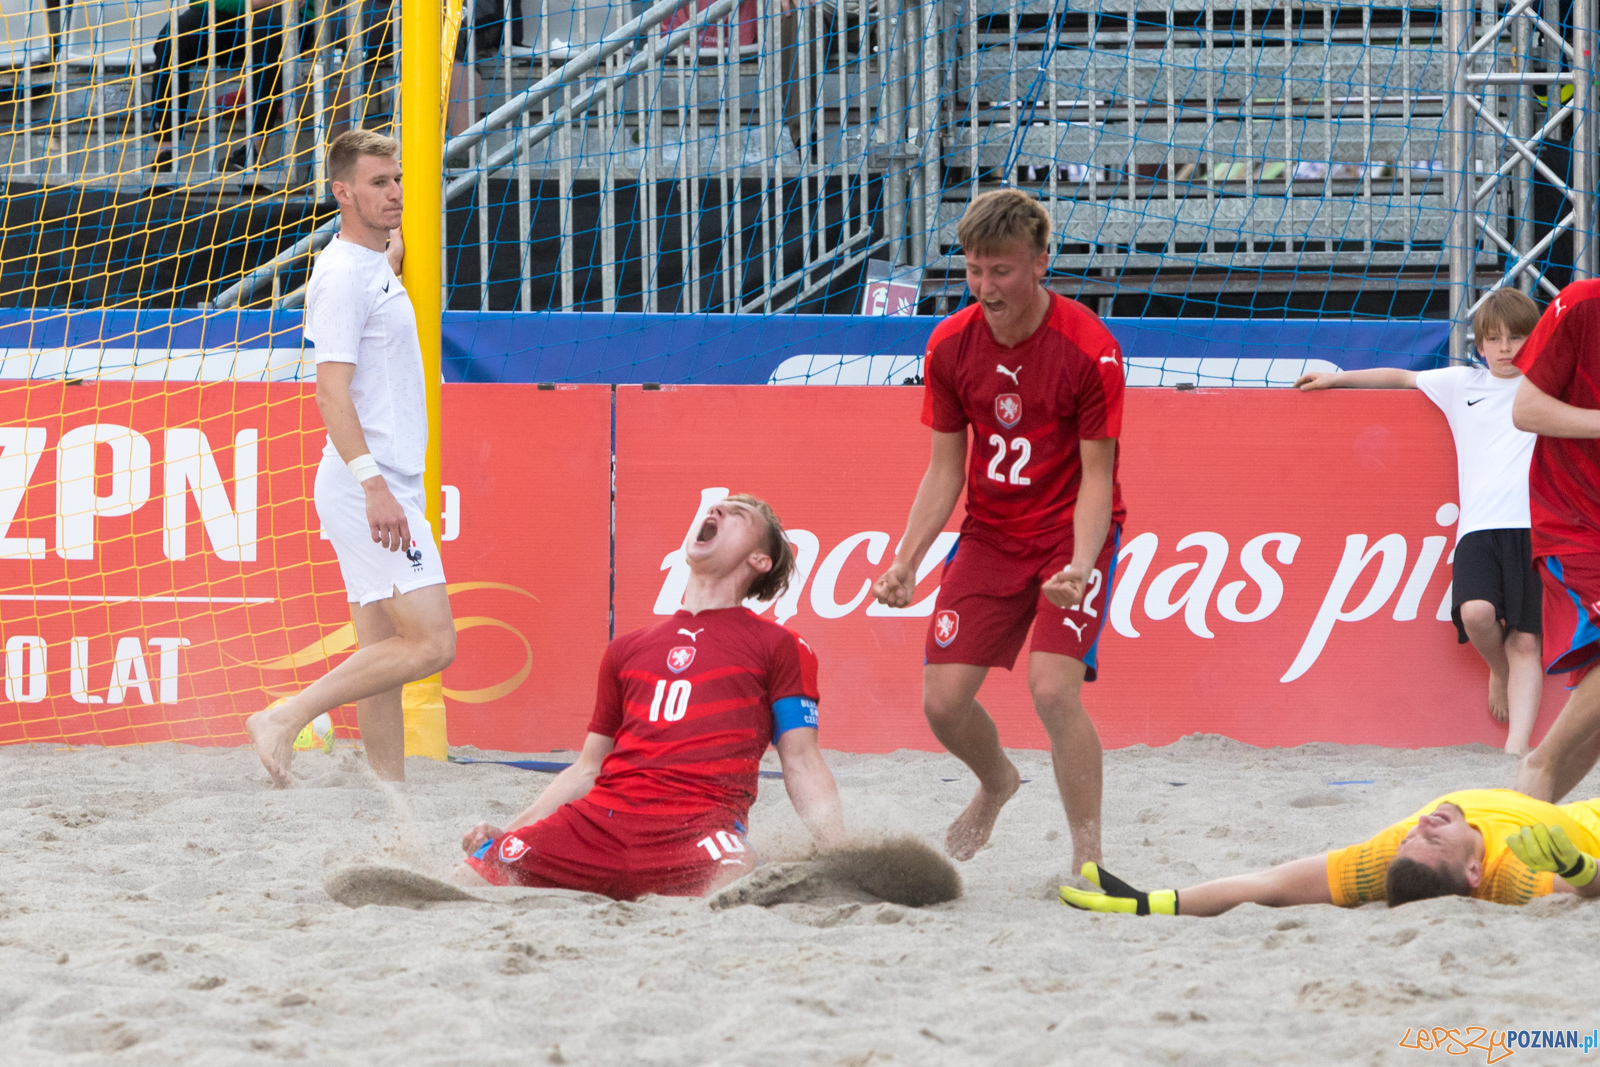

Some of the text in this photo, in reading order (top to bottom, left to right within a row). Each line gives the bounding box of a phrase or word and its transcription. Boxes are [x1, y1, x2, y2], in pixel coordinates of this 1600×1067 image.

[987, 434, 1031, 485] 22
[70, 636, 191, 705] LAT
[649, 680, 692, 721] 10
[697, 831, 746, 861] 10
